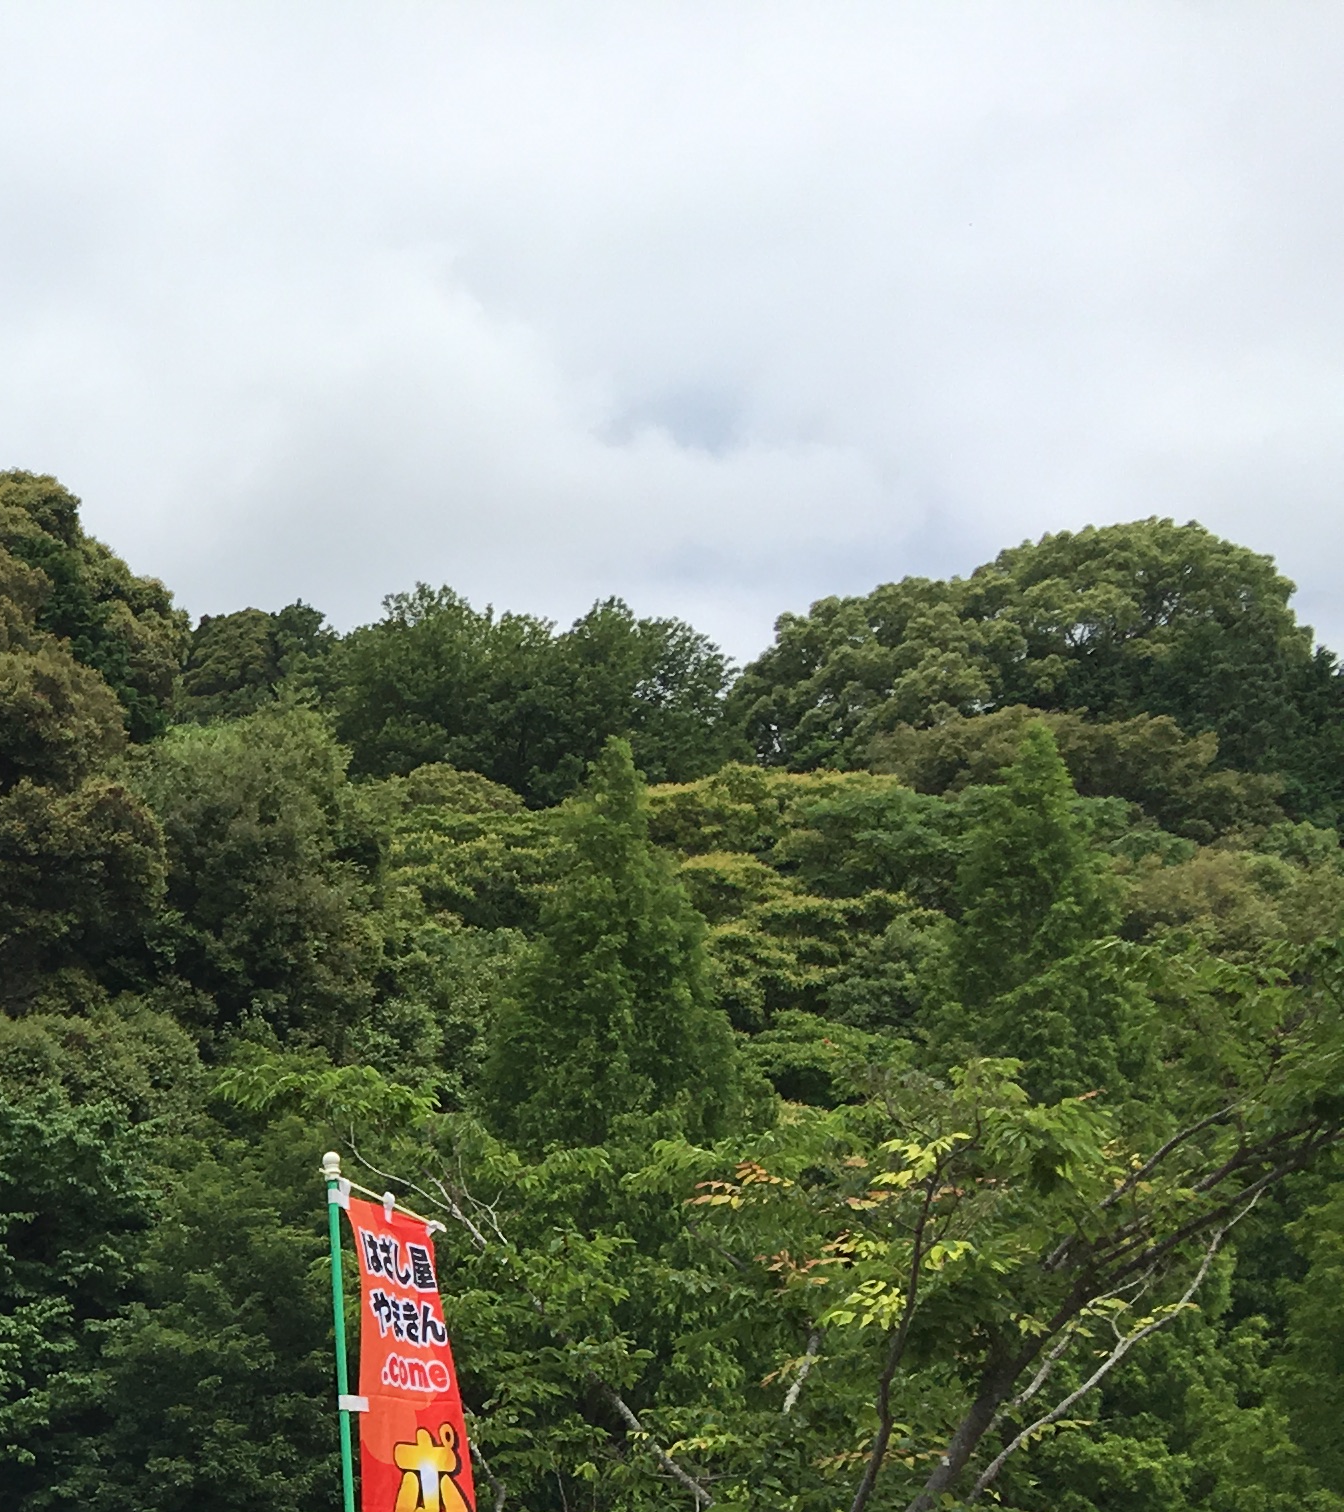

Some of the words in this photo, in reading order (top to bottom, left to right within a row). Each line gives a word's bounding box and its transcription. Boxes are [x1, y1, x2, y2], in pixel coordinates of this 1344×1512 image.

[372, 1290, 447, 1345] やまきん
[383, 1355, 449, 1391] .come
